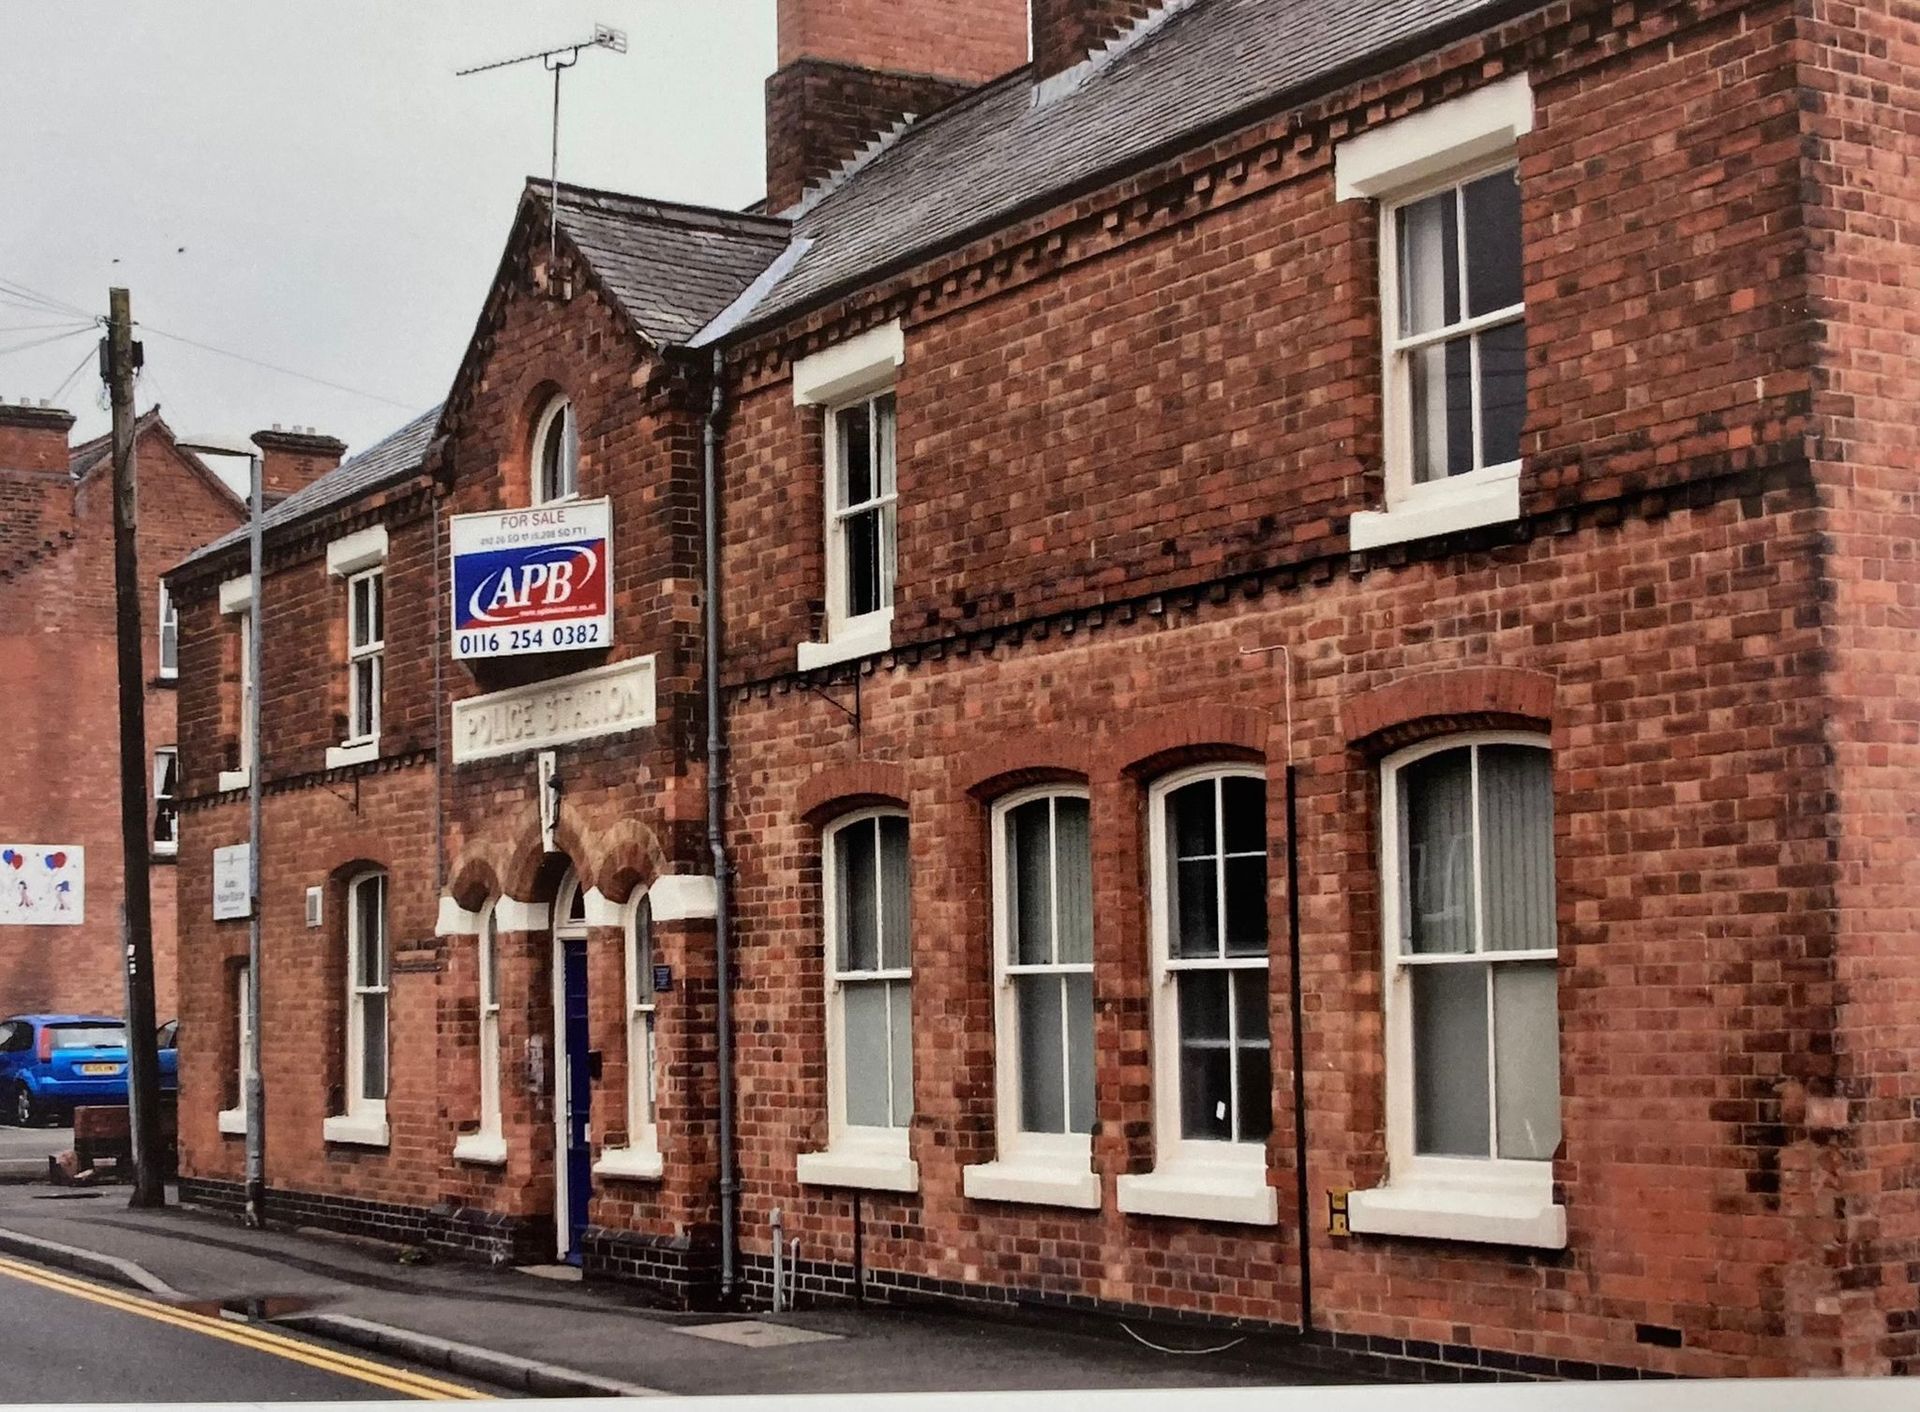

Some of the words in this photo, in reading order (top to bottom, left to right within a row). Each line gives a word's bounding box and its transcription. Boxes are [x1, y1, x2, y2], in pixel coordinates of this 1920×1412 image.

[501, 515, 528, 529] FOR
[532, 511, 565, 526] SALE
[557, 527, 570, 538] SQ
[487, 561, 573, 610] APB
[460, 633, 499, 654] 0116
[510, 629, 543, 649] 254
[552, 623, 599, 646] 0382
[464, 702, 536, 748] POLICE
